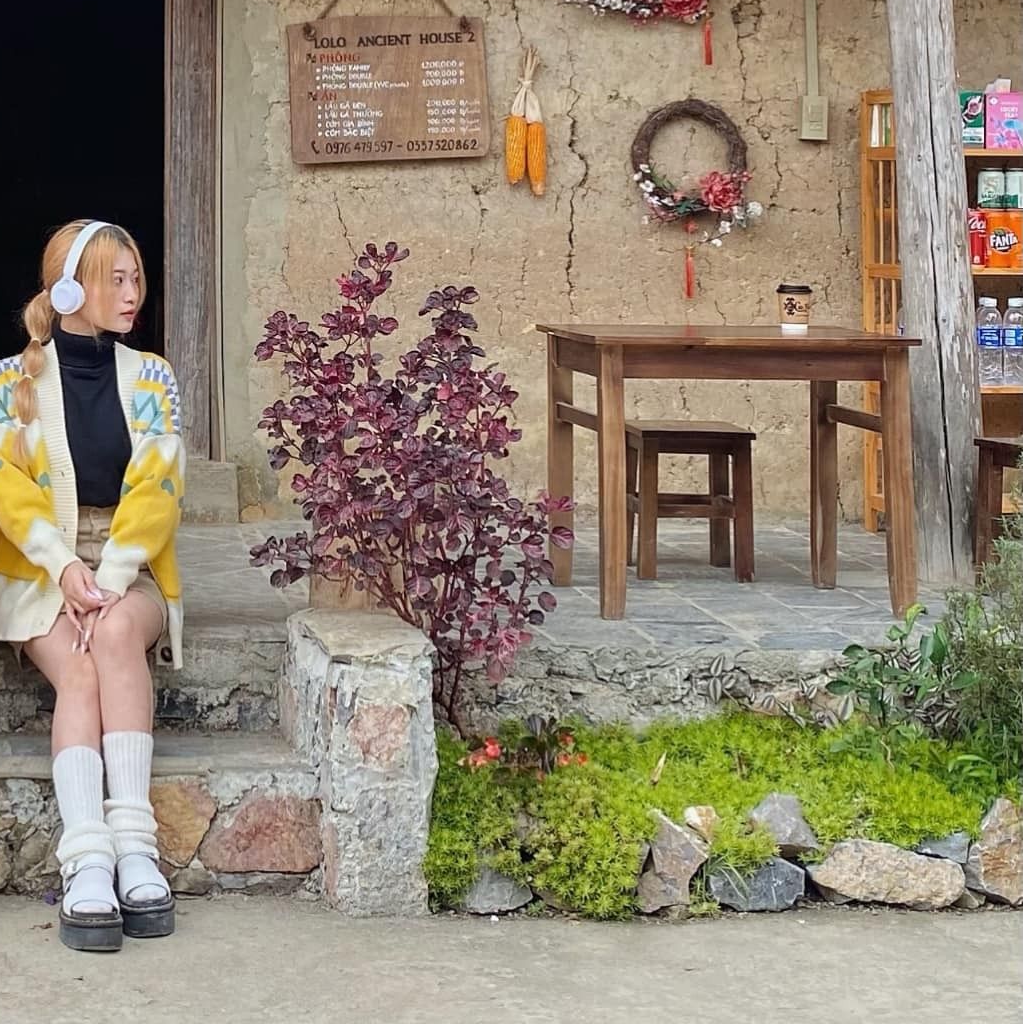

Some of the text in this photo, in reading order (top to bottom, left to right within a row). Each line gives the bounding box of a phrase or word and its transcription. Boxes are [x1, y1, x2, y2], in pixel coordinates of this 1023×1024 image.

[314, 31, 476, 49] LOLO ANCIENT HOUSE 2
[990, 232, 1018, 247] FANTA
